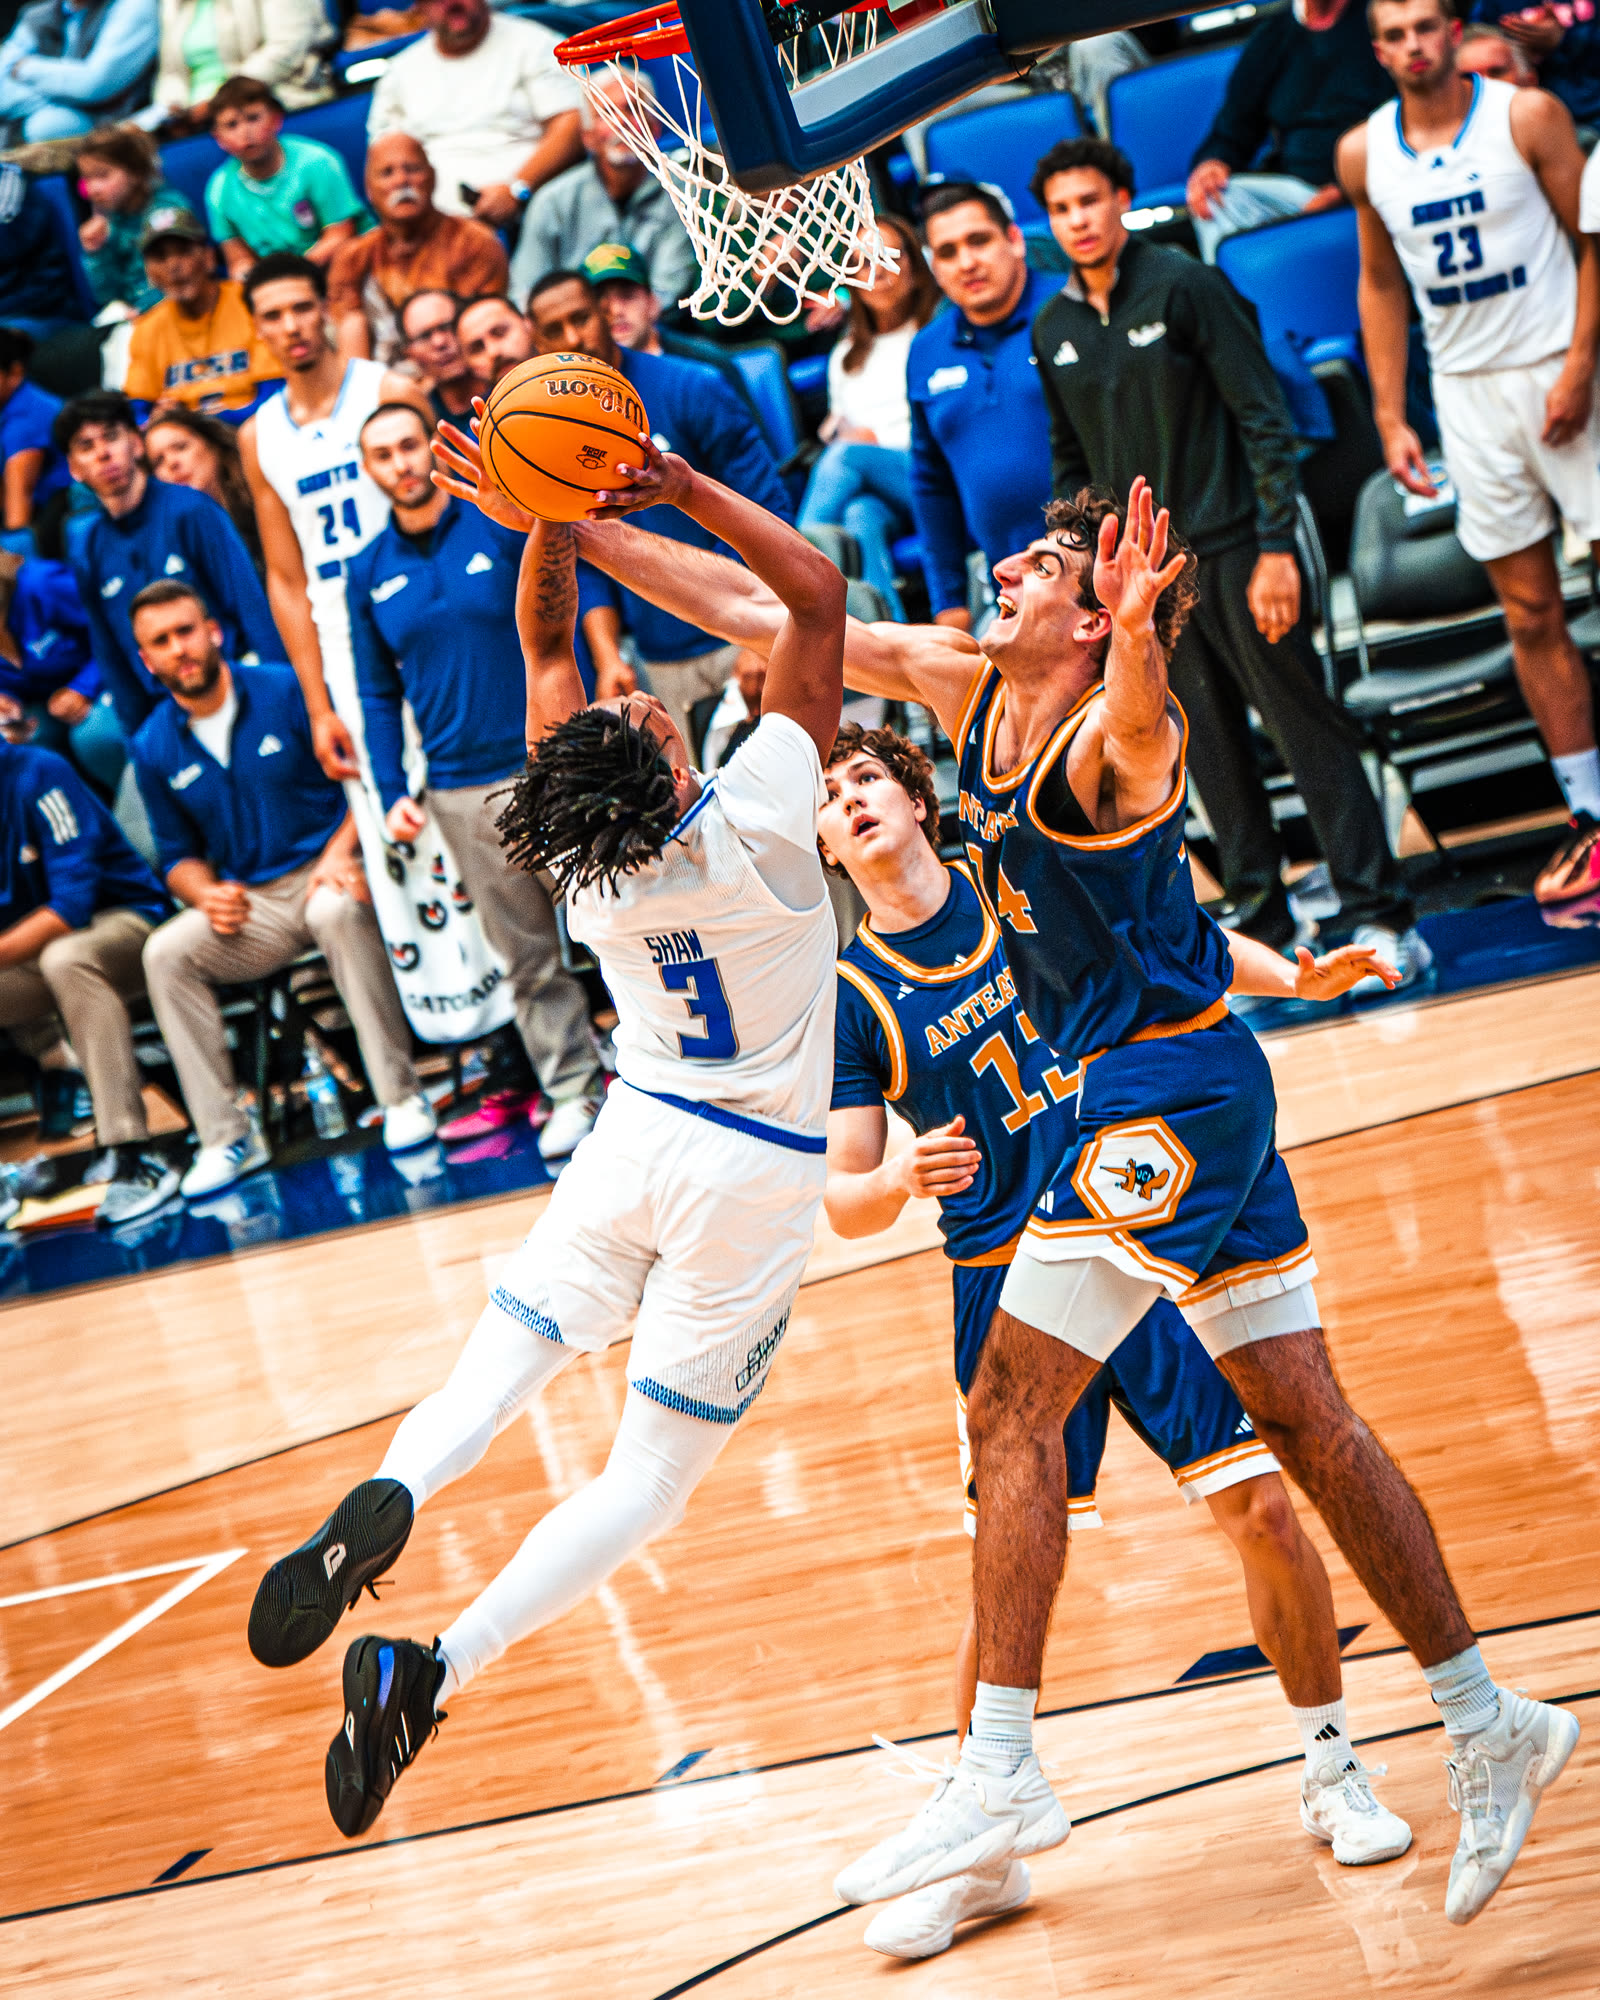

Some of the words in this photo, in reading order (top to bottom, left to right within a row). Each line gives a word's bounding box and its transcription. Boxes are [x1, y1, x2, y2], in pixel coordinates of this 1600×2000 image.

[1432, 224, 1484, 278] 23
[545, 379, 645, 434] Wilson
[317, 497, 362, 545] 24
[643, 928, 704, 964] SHAW
[658, 957, 741, 1060] 3
[1136, 1169, 1152, 1183] UCI
